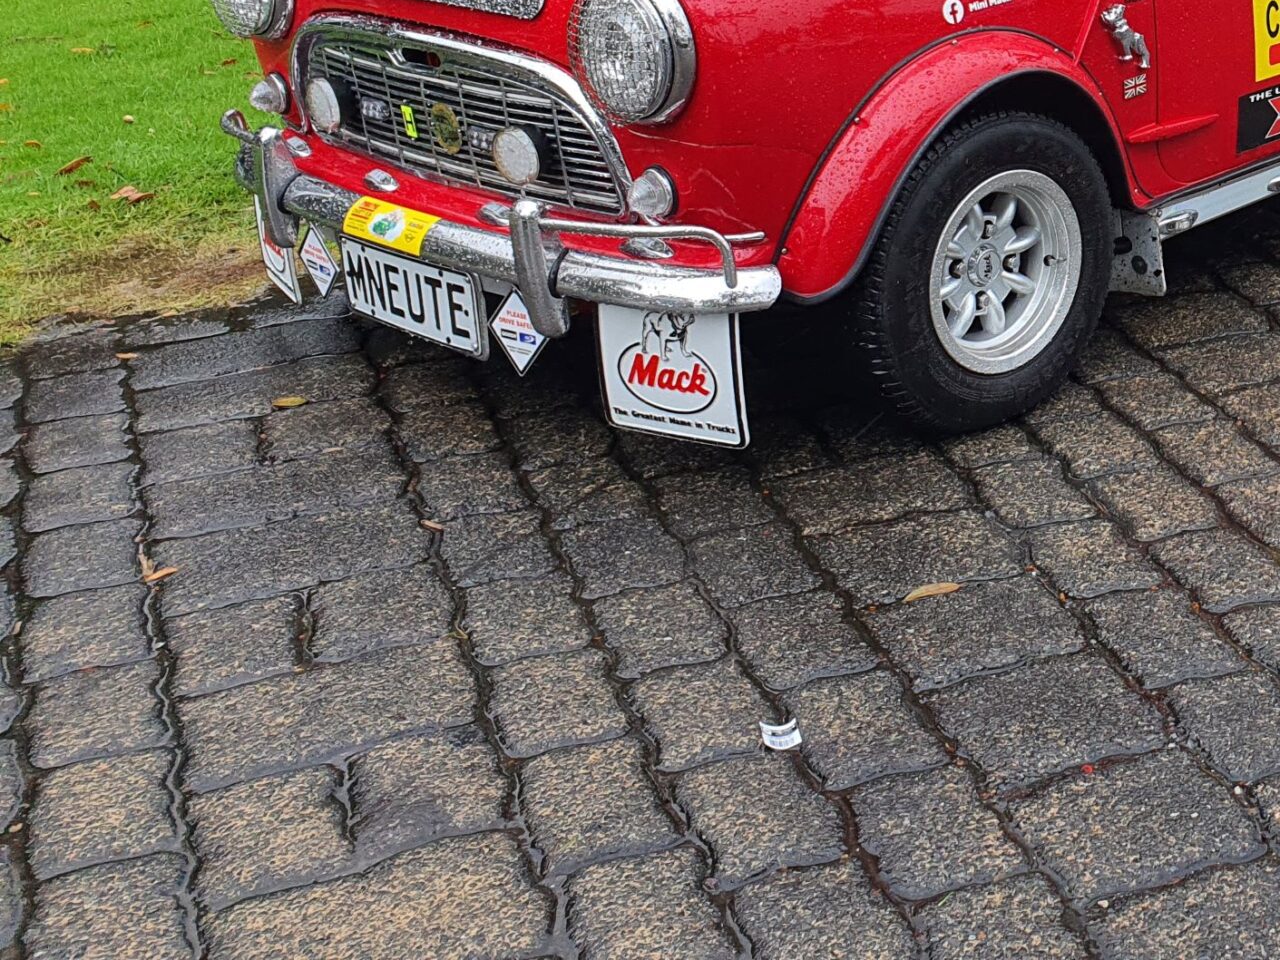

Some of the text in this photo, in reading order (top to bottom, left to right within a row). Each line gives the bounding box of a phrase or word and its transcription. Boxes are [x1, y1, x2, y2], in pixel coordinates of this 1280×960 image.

[968, 0, 989, 13] Mini
[1249, 89, 1273, 103] THE
[346, 250, 471, 339] MNEUTE
[506, 309, 527, 320] PLEASE
[627, 352, 711, 396] Mack
[612, 406, 737, 434] The Greatest Name in Trucks
